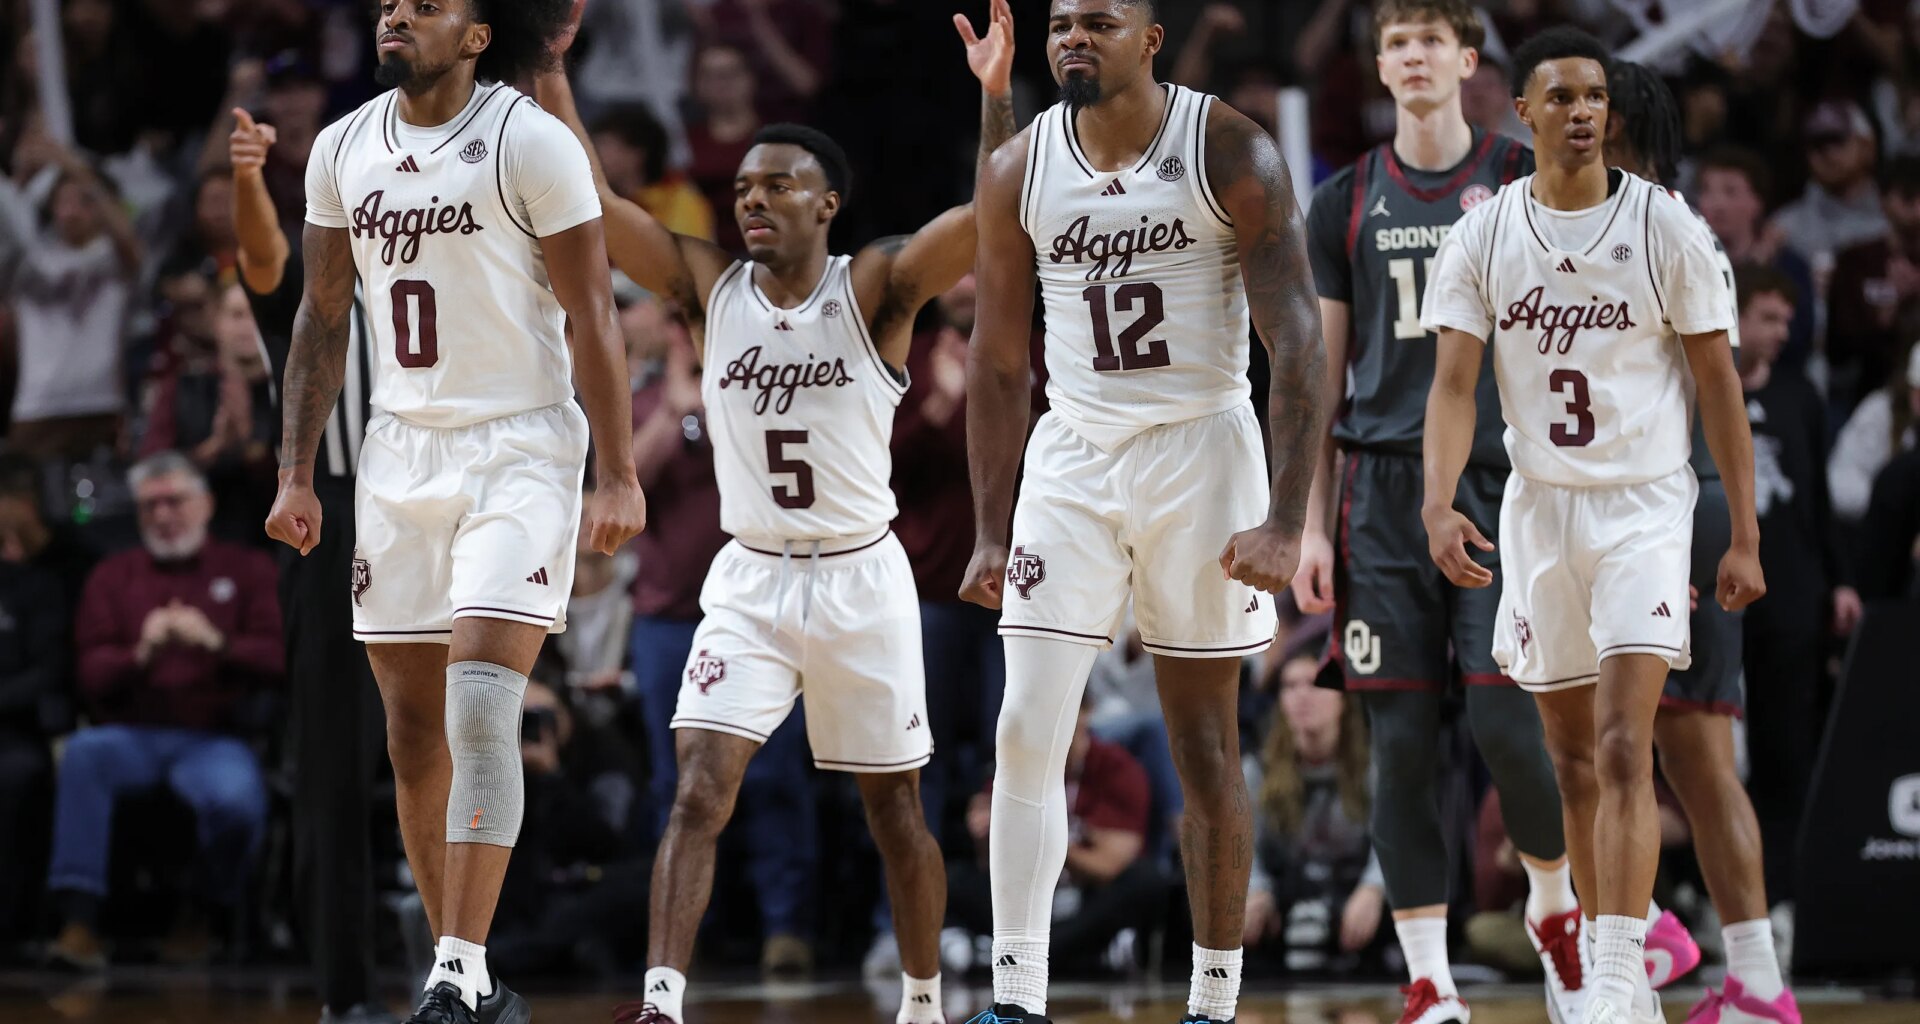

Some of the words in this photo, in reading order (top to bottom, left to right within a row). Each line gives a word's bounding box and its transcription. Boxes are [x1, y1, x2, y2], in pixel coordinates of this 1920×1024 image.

[467, 141, 483, 156] SEC
[1162, 158, 1180, 174] SEC
[353, 190, 484, 266] Aggies
[1050, 215, 1198, 282] Aggies
[1614, 246, 1630, 261] SEC
[390, 279, 439, 368] 0
[1082, 281, 1171, 372] 12
[1388, 257, 1437, 340] 1
[1500, 286, 1636, 355] Aggies
[720, 346, 855, 416] Aggies
[1549, 368, 1596, 447] 3
[765, 429, 816, 509] 5
[1344, 619, 1381, 675] OU
